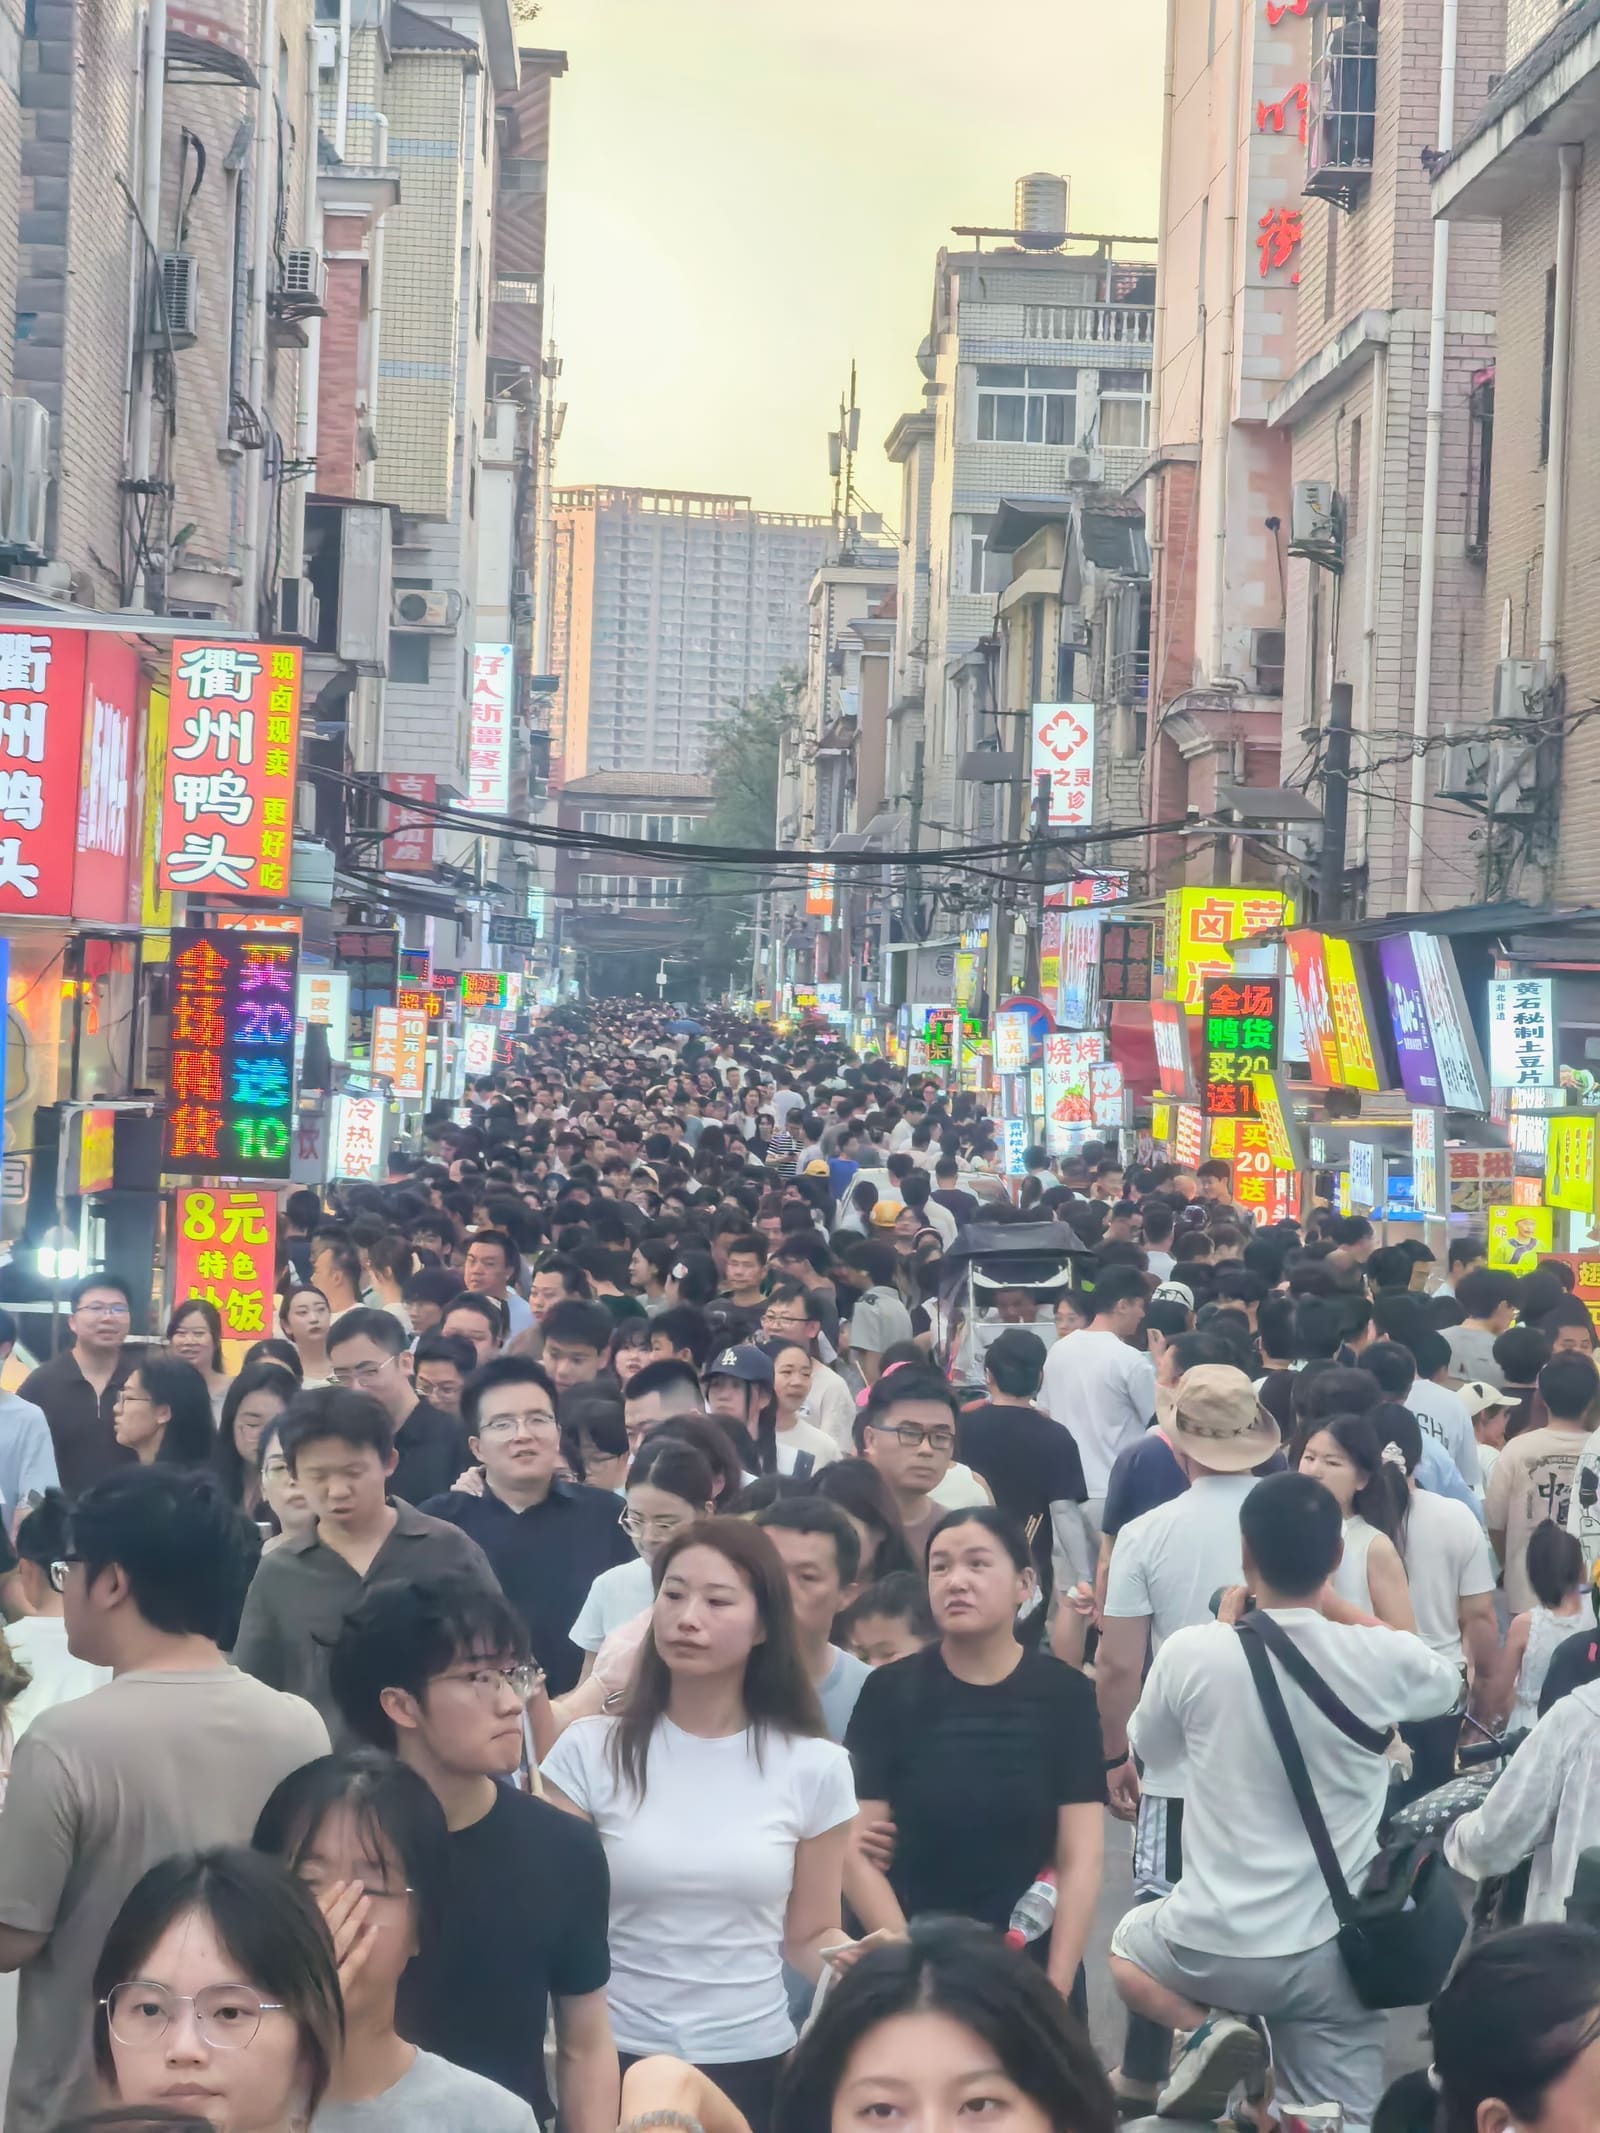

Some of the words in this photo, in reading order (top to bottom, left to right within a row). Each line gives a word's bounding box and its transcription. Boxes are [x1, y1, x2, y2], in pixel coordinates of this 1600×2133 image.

[265, 651, 295, 778] 现卤现卖
[166, 647, 263, 889] 衢州鸭头
[259, 797, 287, 891] 更好吃
[1189, 896, 1282, 944] 卤菜
[1208, 984, 1274, 1017] 全场
[1046, 1035, 1101, 1066] 烧烤
[1207, 1018, 1276, 1050] 鸭货
[1512, 981, 1546, 1085] 黄石秘制土豆片
[343, 1097, 377, 1178] 冷热饮
[1236, 1151, 1272, 1173] 20
[1238, 1176, 1267, 1203] 送
[182, 1191, 270, 1245] 8元
[197, 1250, 258, 1281] 特色
